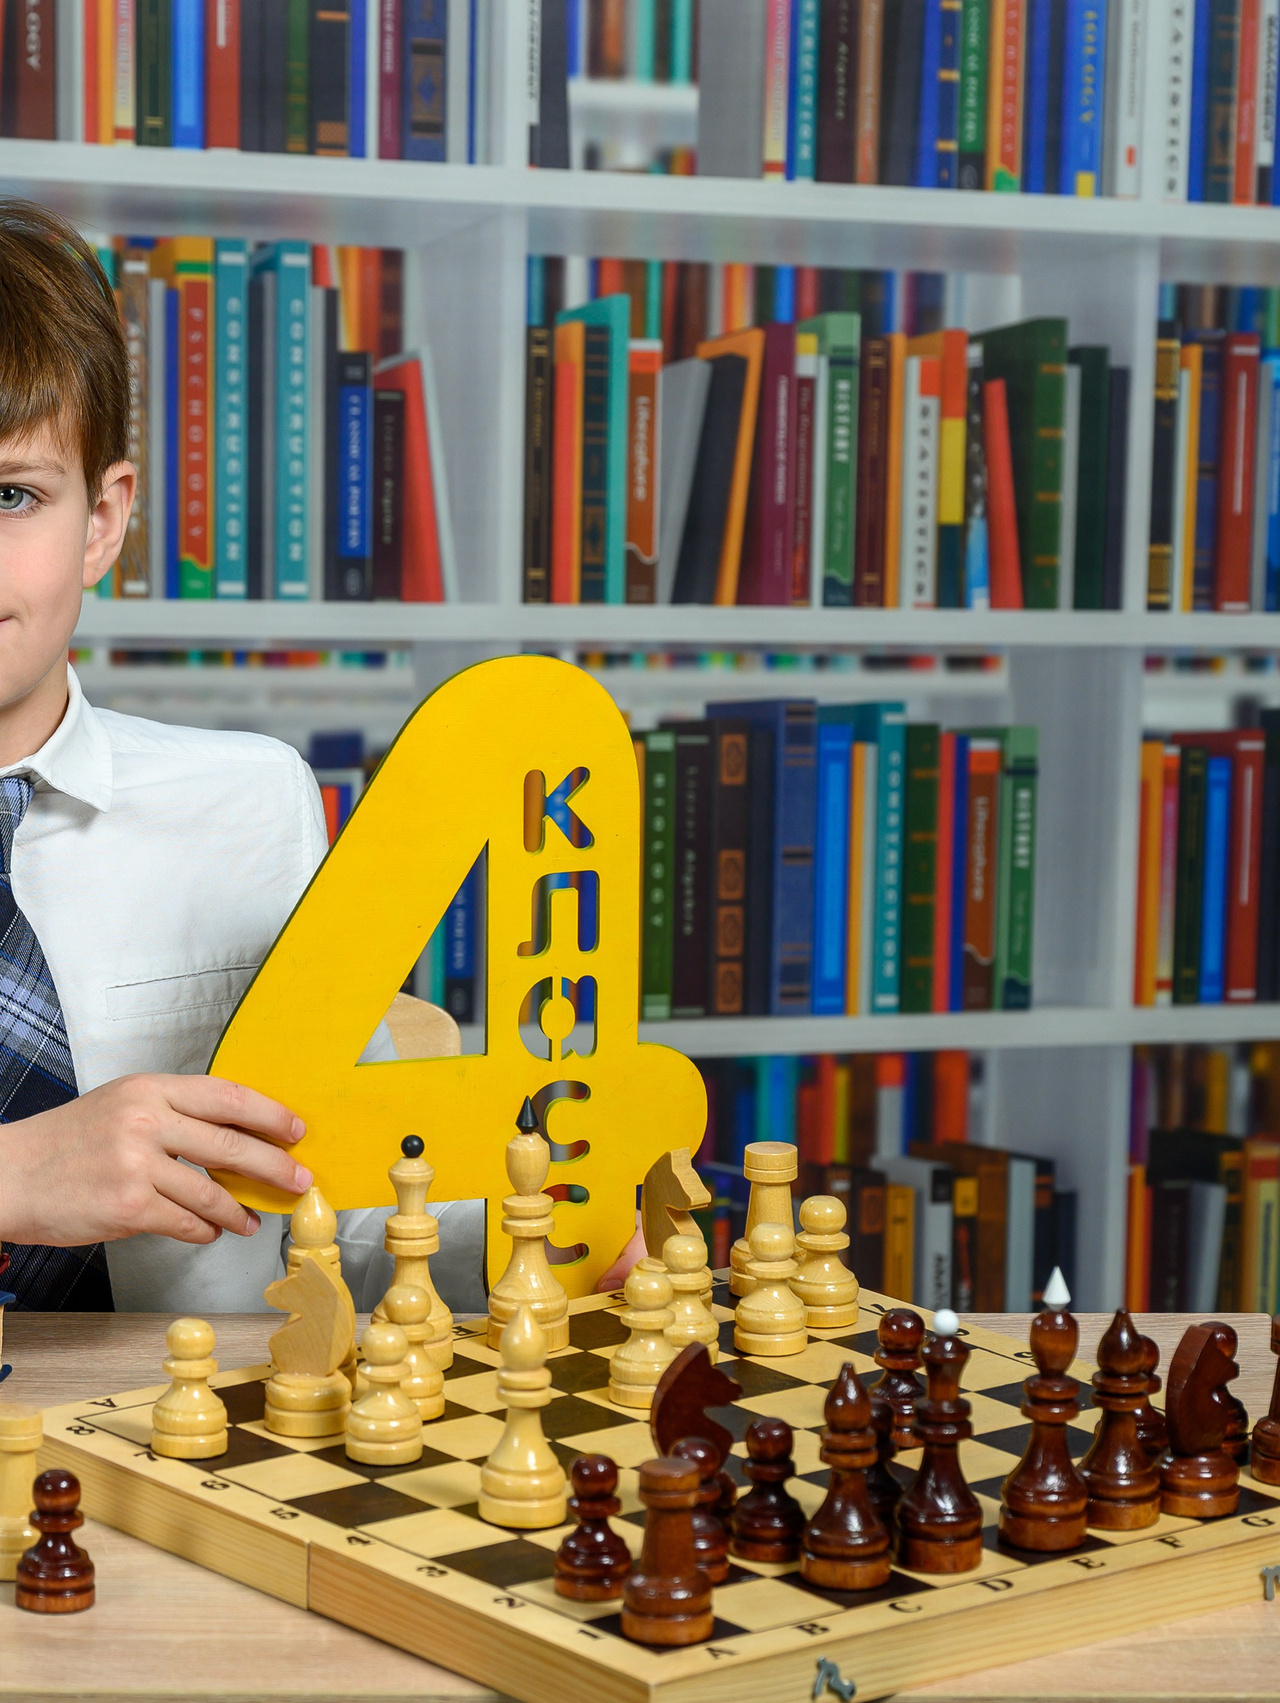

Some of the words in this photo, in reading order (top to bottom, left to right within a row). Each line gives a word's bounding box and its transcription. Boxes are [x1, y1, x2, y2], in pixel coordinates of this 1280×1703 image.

[187, 307, 204, 538] PSYCHOLOGY
[833, 378, 851, 463] HISTORY
[225, 296, 241, 561] CONSTRUCTION
[289, 298, 304, 561] CONSTRUCTION
[633, 395, 650, 502] Literature
[972, 795, 988, 902] Literature
[66, 1425, 96, 1436] 8
[133, 1450, 159, 1463] 7
[269, 1507, 301, 1521] 5
[1240, 1515, 1276, 1528] G
[346, 1534, 376, 1547] 4
[1153, 1535, 1185, 1550] F
[1067, 1556, 1107, 1570] E
[417, 1565, 450, 1578] 3
[973, 1578, 1016, 1594] D
[493, 1596, 527, 1610] 2
[888, 1600, 923, 1614] C
[577, 1628, 606, 1641] 1
[793, 1622, 831, 1637] B
[704, 1644, 739, 1661] A
